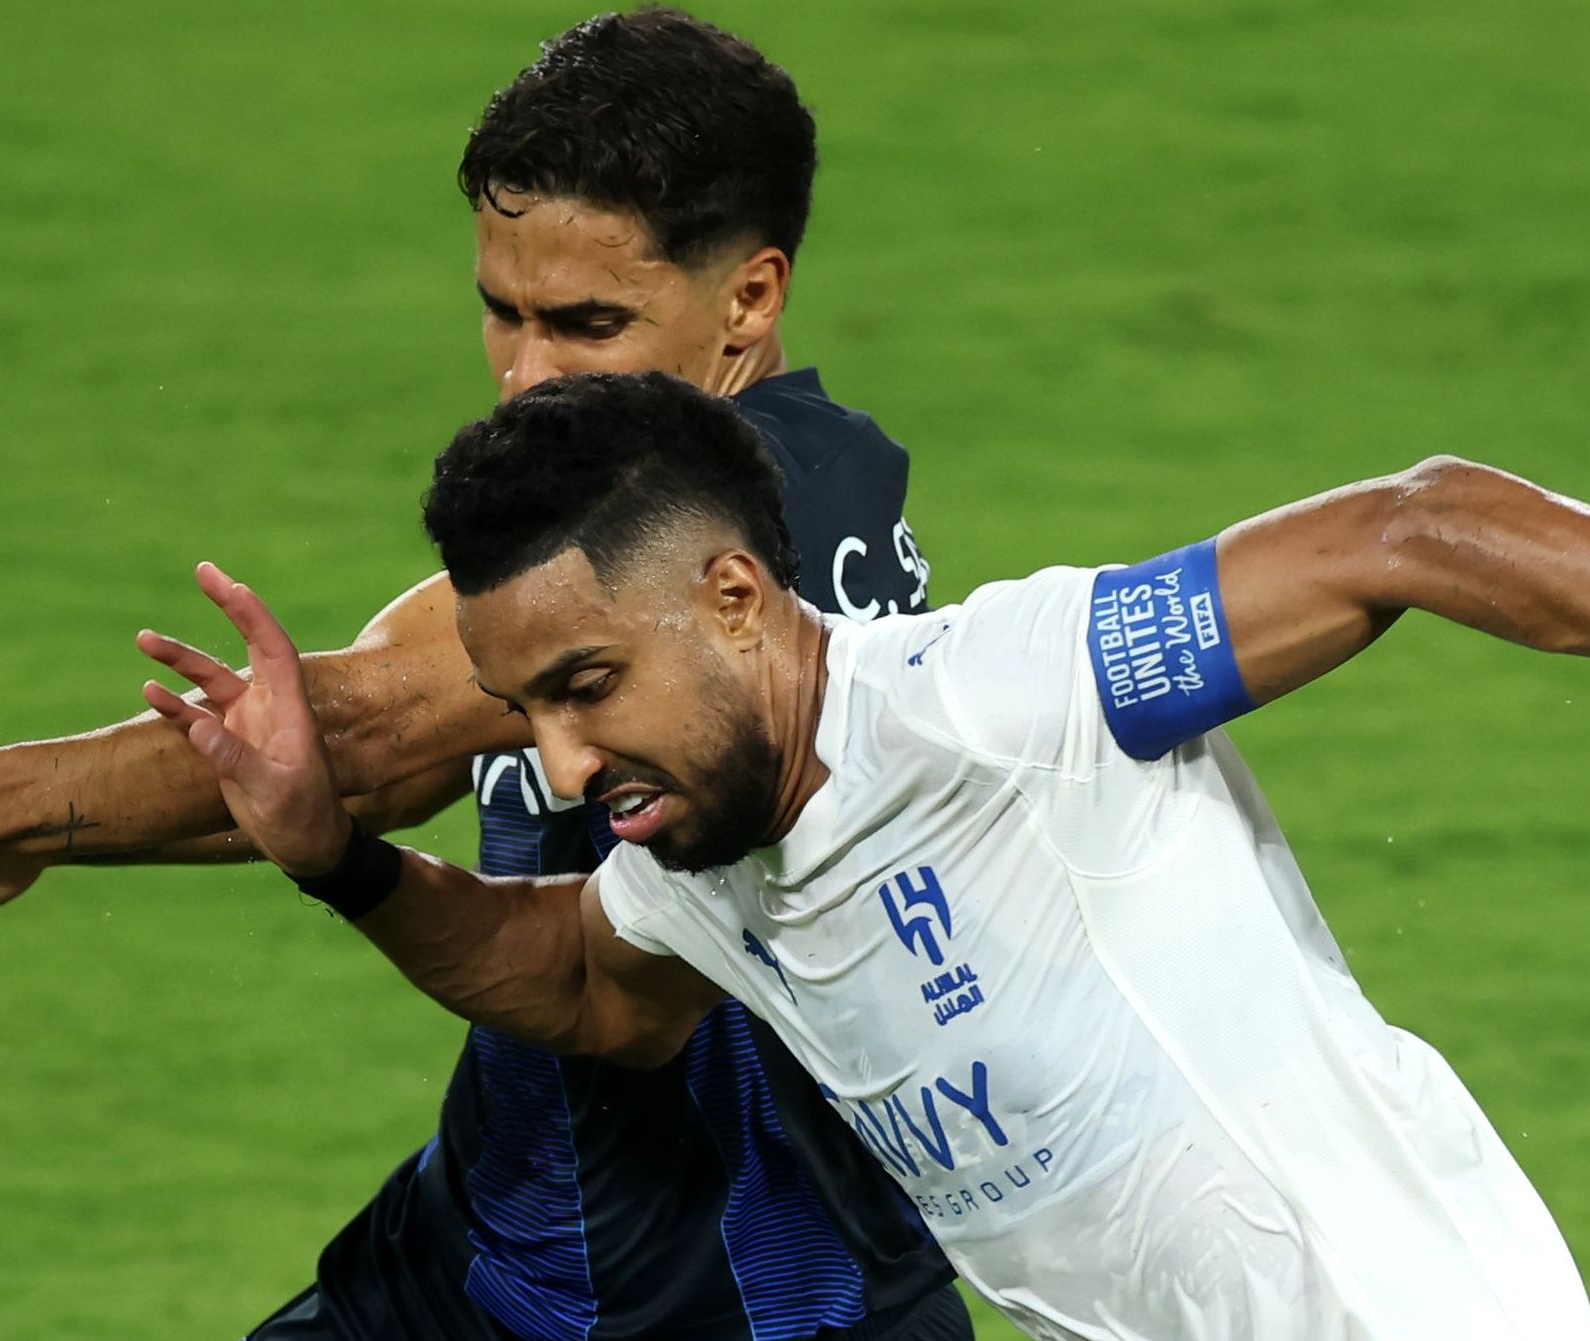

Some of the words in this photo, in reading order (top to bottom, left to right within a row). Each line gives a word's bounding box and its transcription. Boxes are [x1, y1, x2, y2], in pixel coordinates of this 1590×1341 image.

[1119, 583, 1172, 701] UNITES
[1153, 567, 1192, 650] World
[1194, 595, 1216, 646] FIFA
[1093, 589, 1139, 709] FOOTBALL
[1172, 649, 1205, 697] the
[944, 1148, 1054, 1216] GROUP
